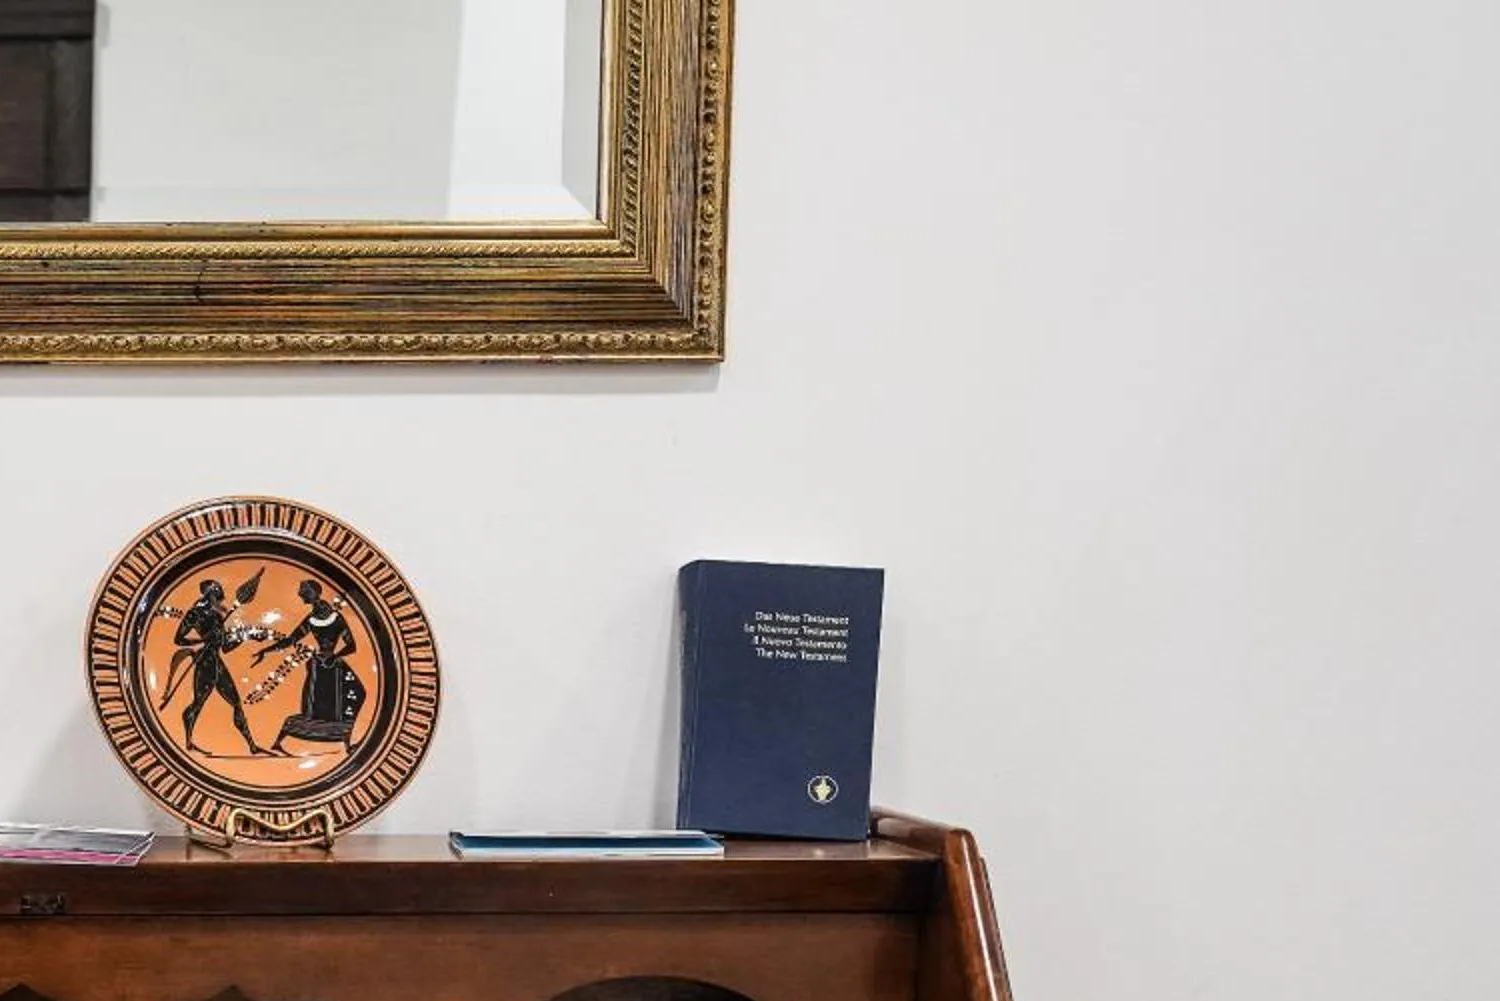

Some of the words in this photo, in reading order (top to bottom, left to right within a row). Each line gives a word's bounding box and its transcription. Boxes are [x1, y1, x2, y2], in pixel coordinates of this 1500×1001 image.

[803, 613, 850, 625] Testament
[802, 625, 849, 637] Testament
[755, 647, 774, 658] The
[775, 648, 798, 660] New
[800, 650, 848, 662] Testament
